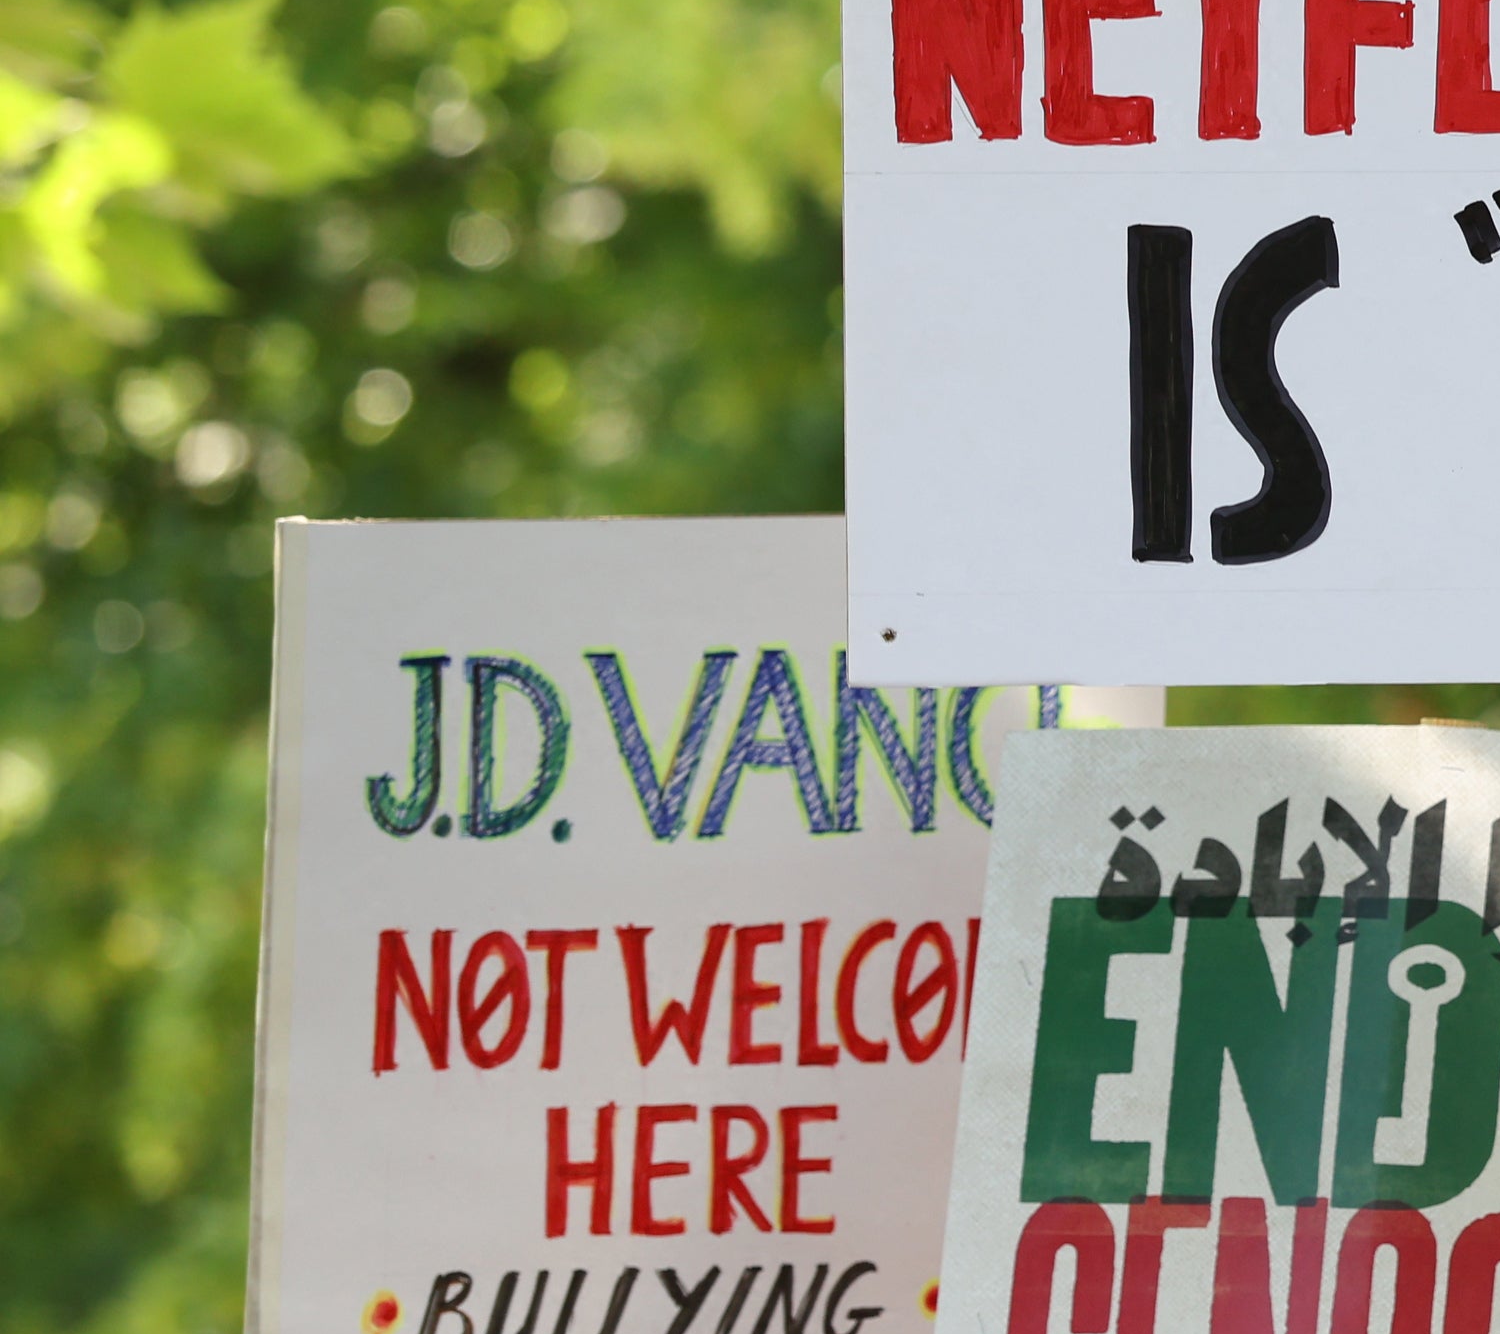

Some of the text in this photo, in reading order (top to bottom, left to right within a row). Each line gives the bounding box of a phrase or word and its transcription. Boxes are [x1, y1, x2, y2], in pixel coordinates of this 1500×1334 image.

[1126, 215, 1341, 565] IS
[366, 651, 573, 841] J.D.
[372, 917, 982, 1077] NOT WELCO
[545, 1103, 838, 1239] HERE
